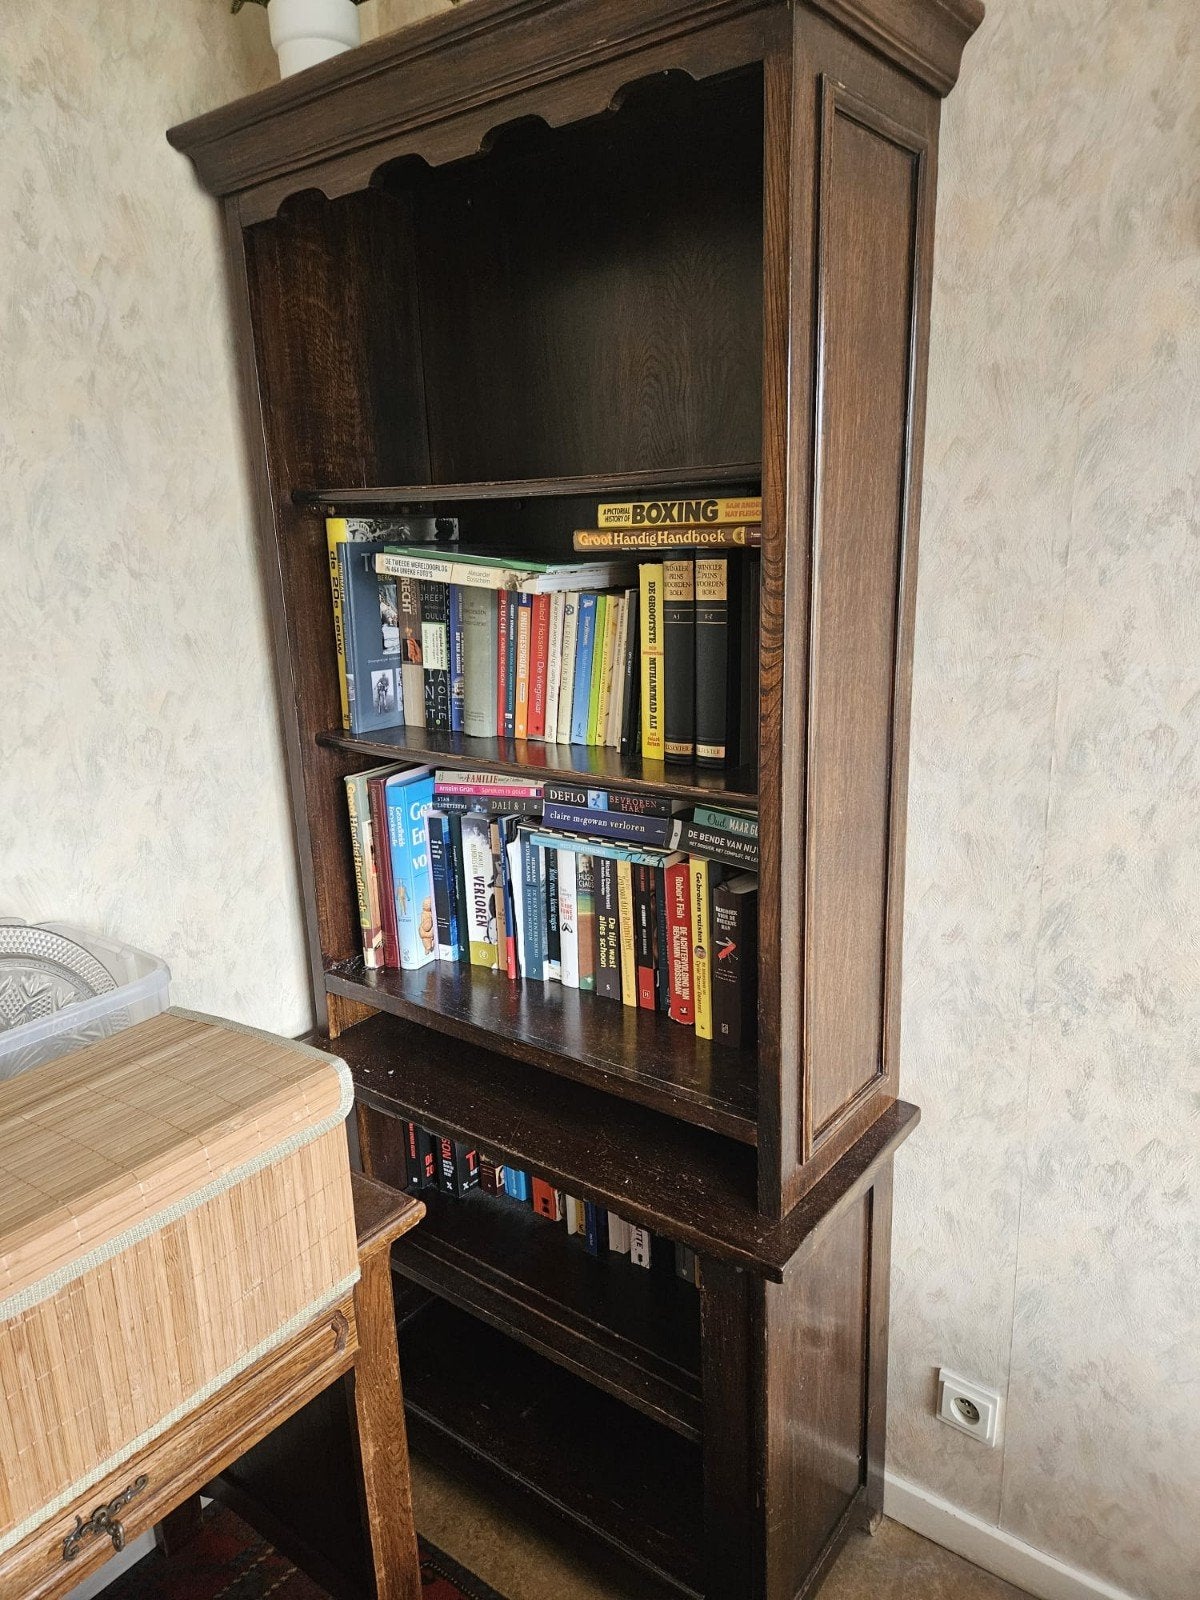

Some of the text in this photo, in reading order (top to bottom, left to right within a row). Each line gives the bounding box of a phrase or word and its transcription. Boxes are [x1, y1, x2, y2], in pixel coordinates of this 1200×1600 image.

[631, 499, 719, 525] BOXING
[579, 529, 726, 548] Groot Handig Handboek
[411, 561, 448, 573] WERELDOORLOG
[329, 551, 337, 569] de
[334, 615, 343, 656] eeuw
[648, 581, 656, 595] DE
[648, 595, 657, 644] GROOTSTE
[518, 611, 528, 679] ONUITGESPROKEN
[537, 623, 546, 659] Hosseini
[536, 660, 544, 673] De
[534, 675, 544, 714] vliegeraar
[649, 657, 657, 730] MUHAMMAD ALI
[466, 773, 498, 784] FAMILIE
[550, 789, 586, 804] DEFLO
[514, 802, 520, 810] &
[609, 795, 657, 808] BEVROREN
[621, 803, 645, 814] HART
[351, 816, 360, 856] Handig
[549, 810, 571, 821] claire
[610, 821, 646, 833] verloren
[729, 818, 749, 834] MAAR
[688, 830, 758, 854] DE BENDE VAN NIJ
[355, 857, 367, 913] Handboek
[473, 875, 488, 928] VERLOREN
[675, 876, 685, 918] Robert Fish
[695, 872, 704, 943] Gebroken vuisten
[598, 915, 607, 968] alles schoon
[608, 917, 616, 968] De tijd wast
[672, 925, 683, 995] BENJAMIN GROSSMAN
[679, 926, 690, 1001] DE ACHTERVOLGING VAN
